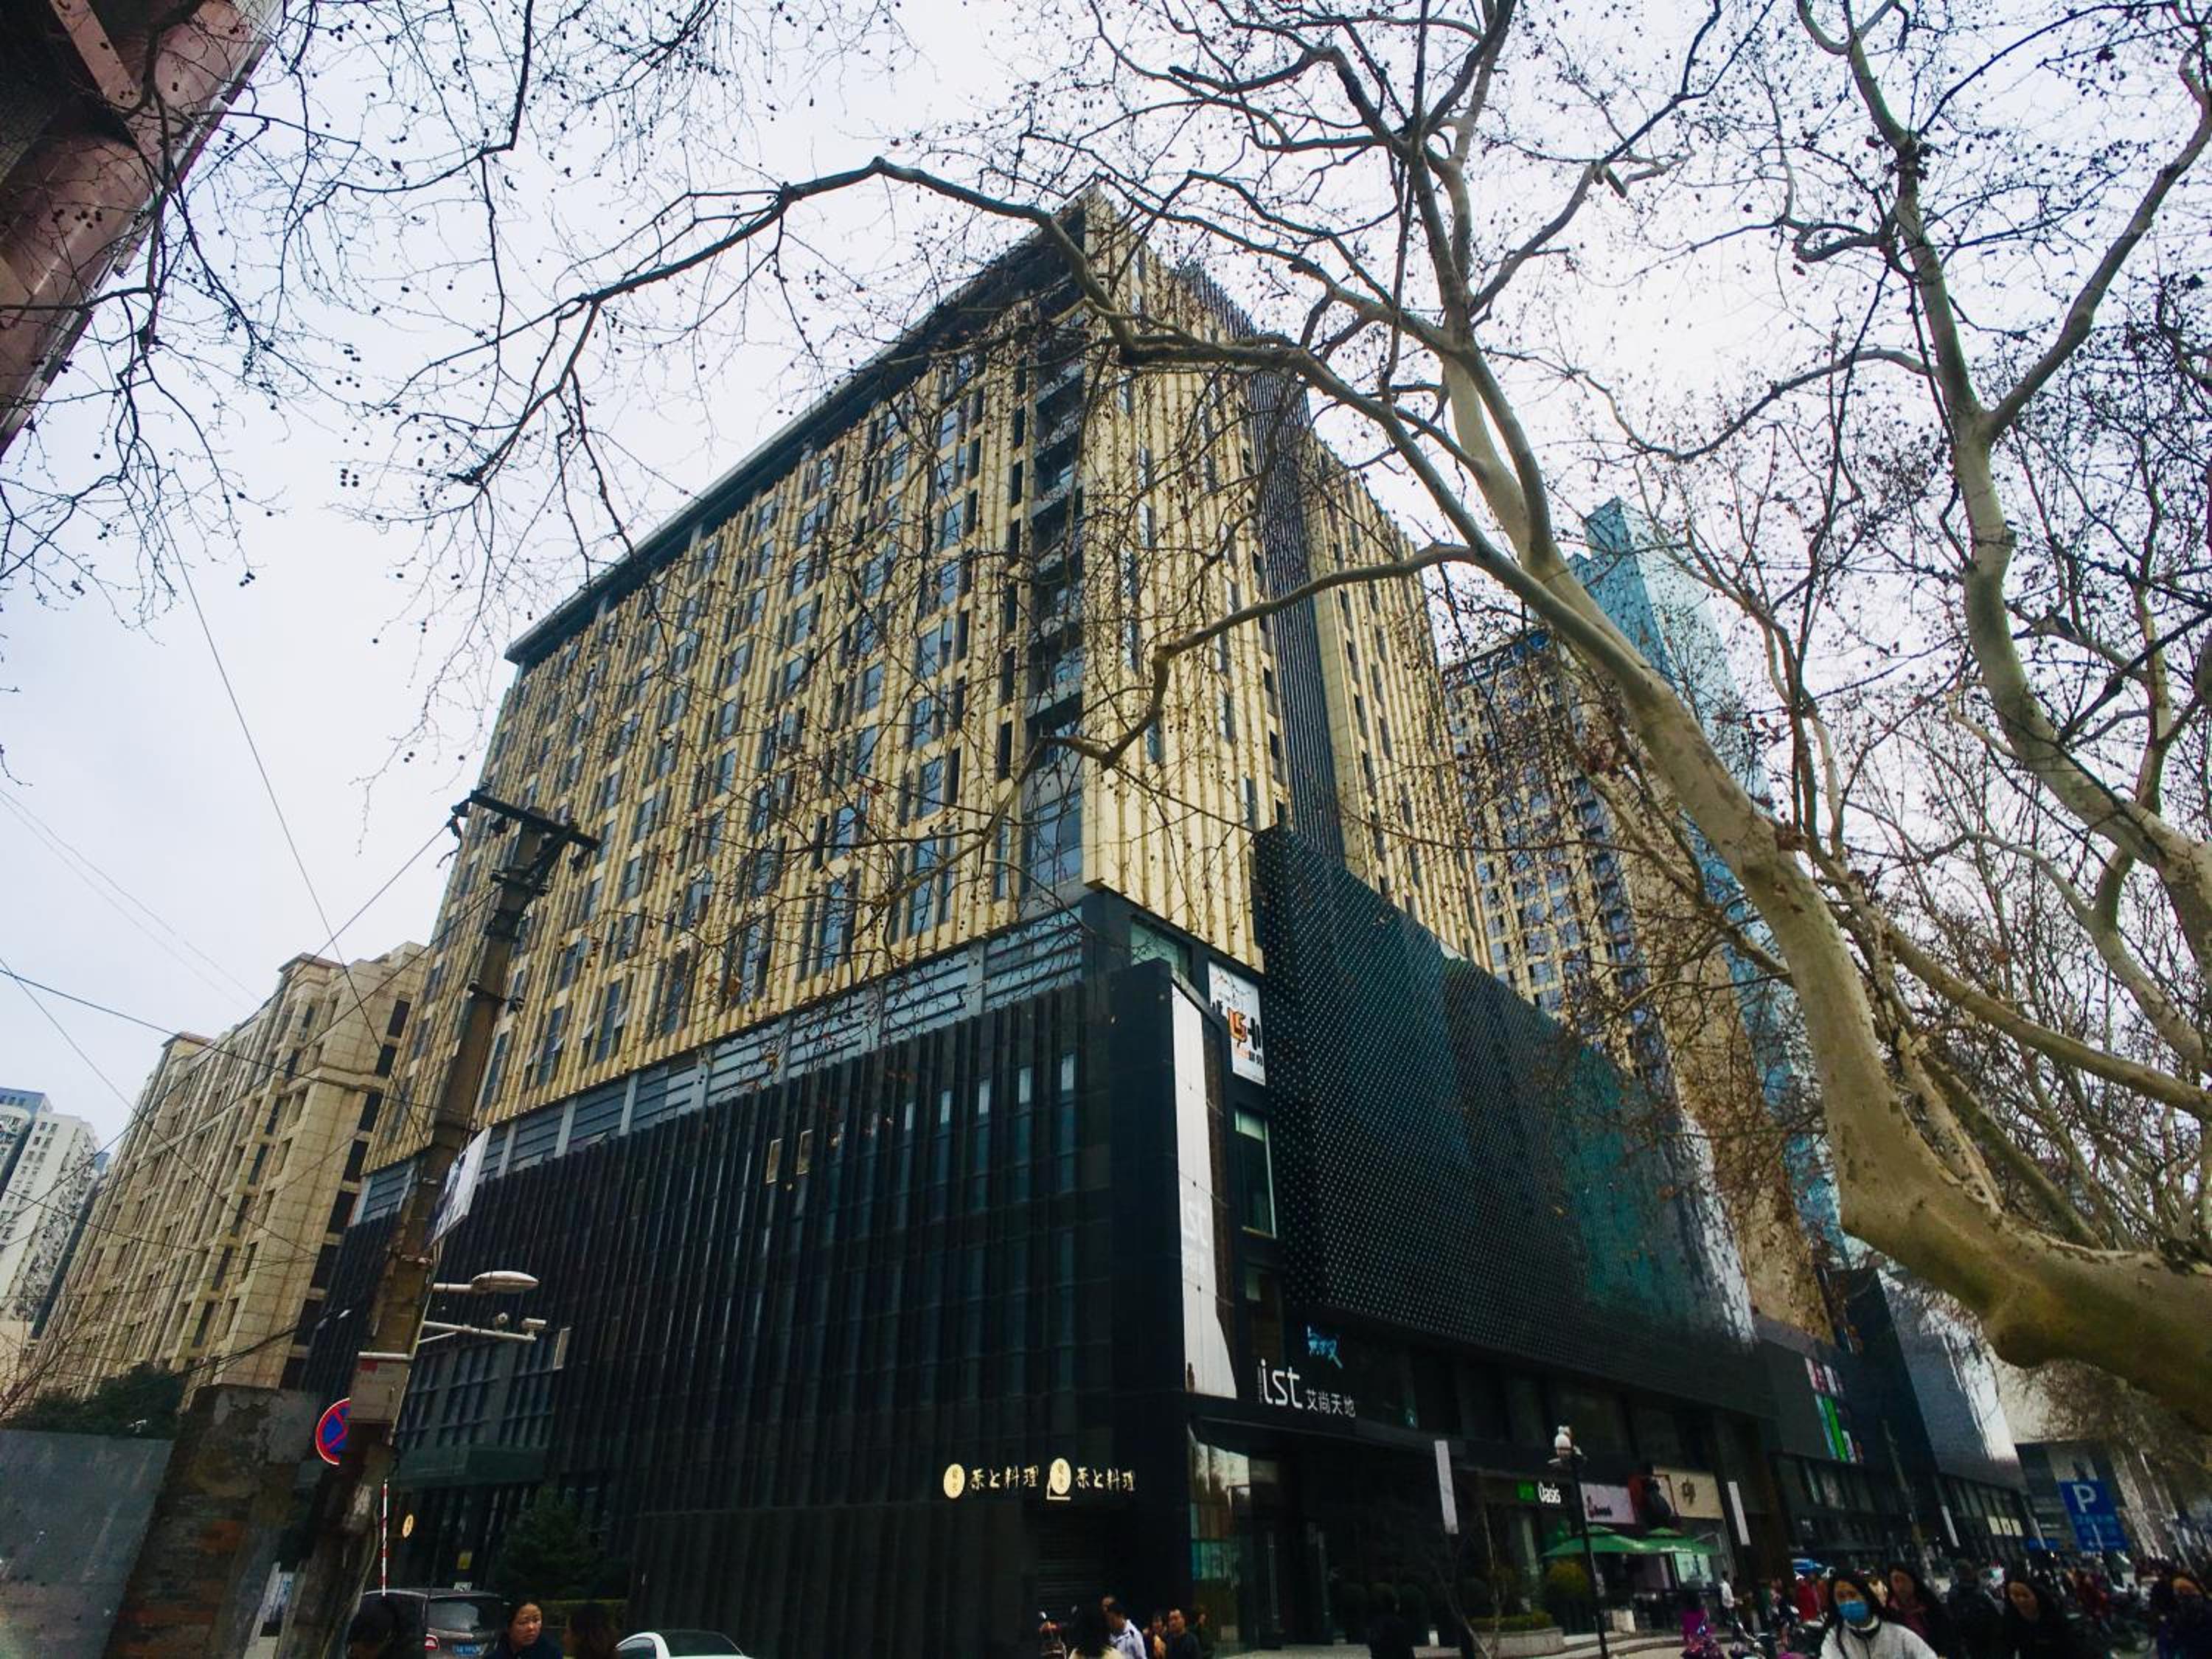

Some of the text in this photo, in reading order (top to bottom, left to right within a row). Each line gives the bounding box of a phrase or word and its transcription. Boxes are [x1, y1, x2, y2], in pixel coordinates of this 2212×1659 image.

[1306, 1386, 1356, 1418] 艾尚天地
[1538, 1481, 1561, 1504] Oasis
[2073, 1484, 2097, 1514] P
